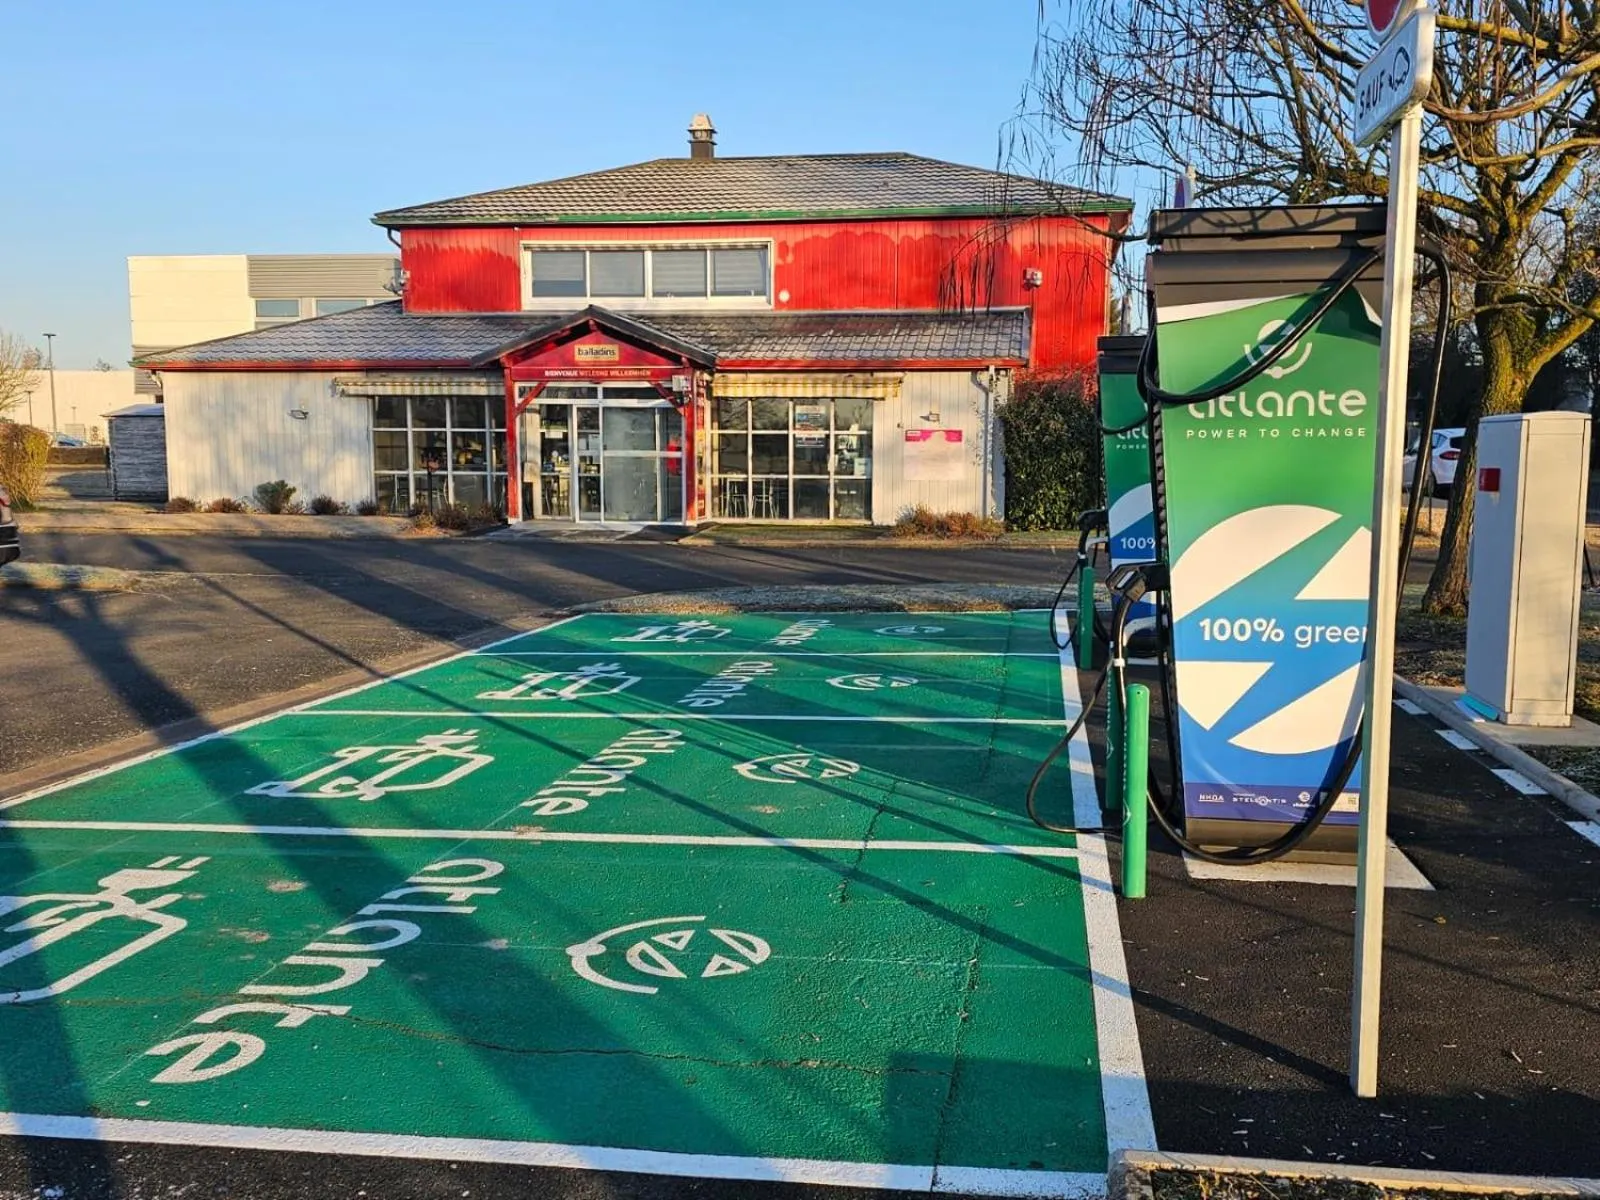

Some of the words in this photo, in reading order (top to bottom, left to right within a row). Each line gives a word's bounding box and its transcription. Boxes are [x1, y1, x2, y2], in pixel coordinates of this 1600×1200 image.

[1359, 68, 1386, 120] SAUF
[577, 347, 616, 356] balladins
[1186, 428, 1248, 438] POWER
[1259, 428, 1280, 438] TO
[1291, 427, 1367, 438] CHANGE
[1199, 617, 1285, 642] 100%
[677, 661, 778, 707] atlante
[519, 729, 686, 815] atlante
[145, 857, 506, 1085] atlante
